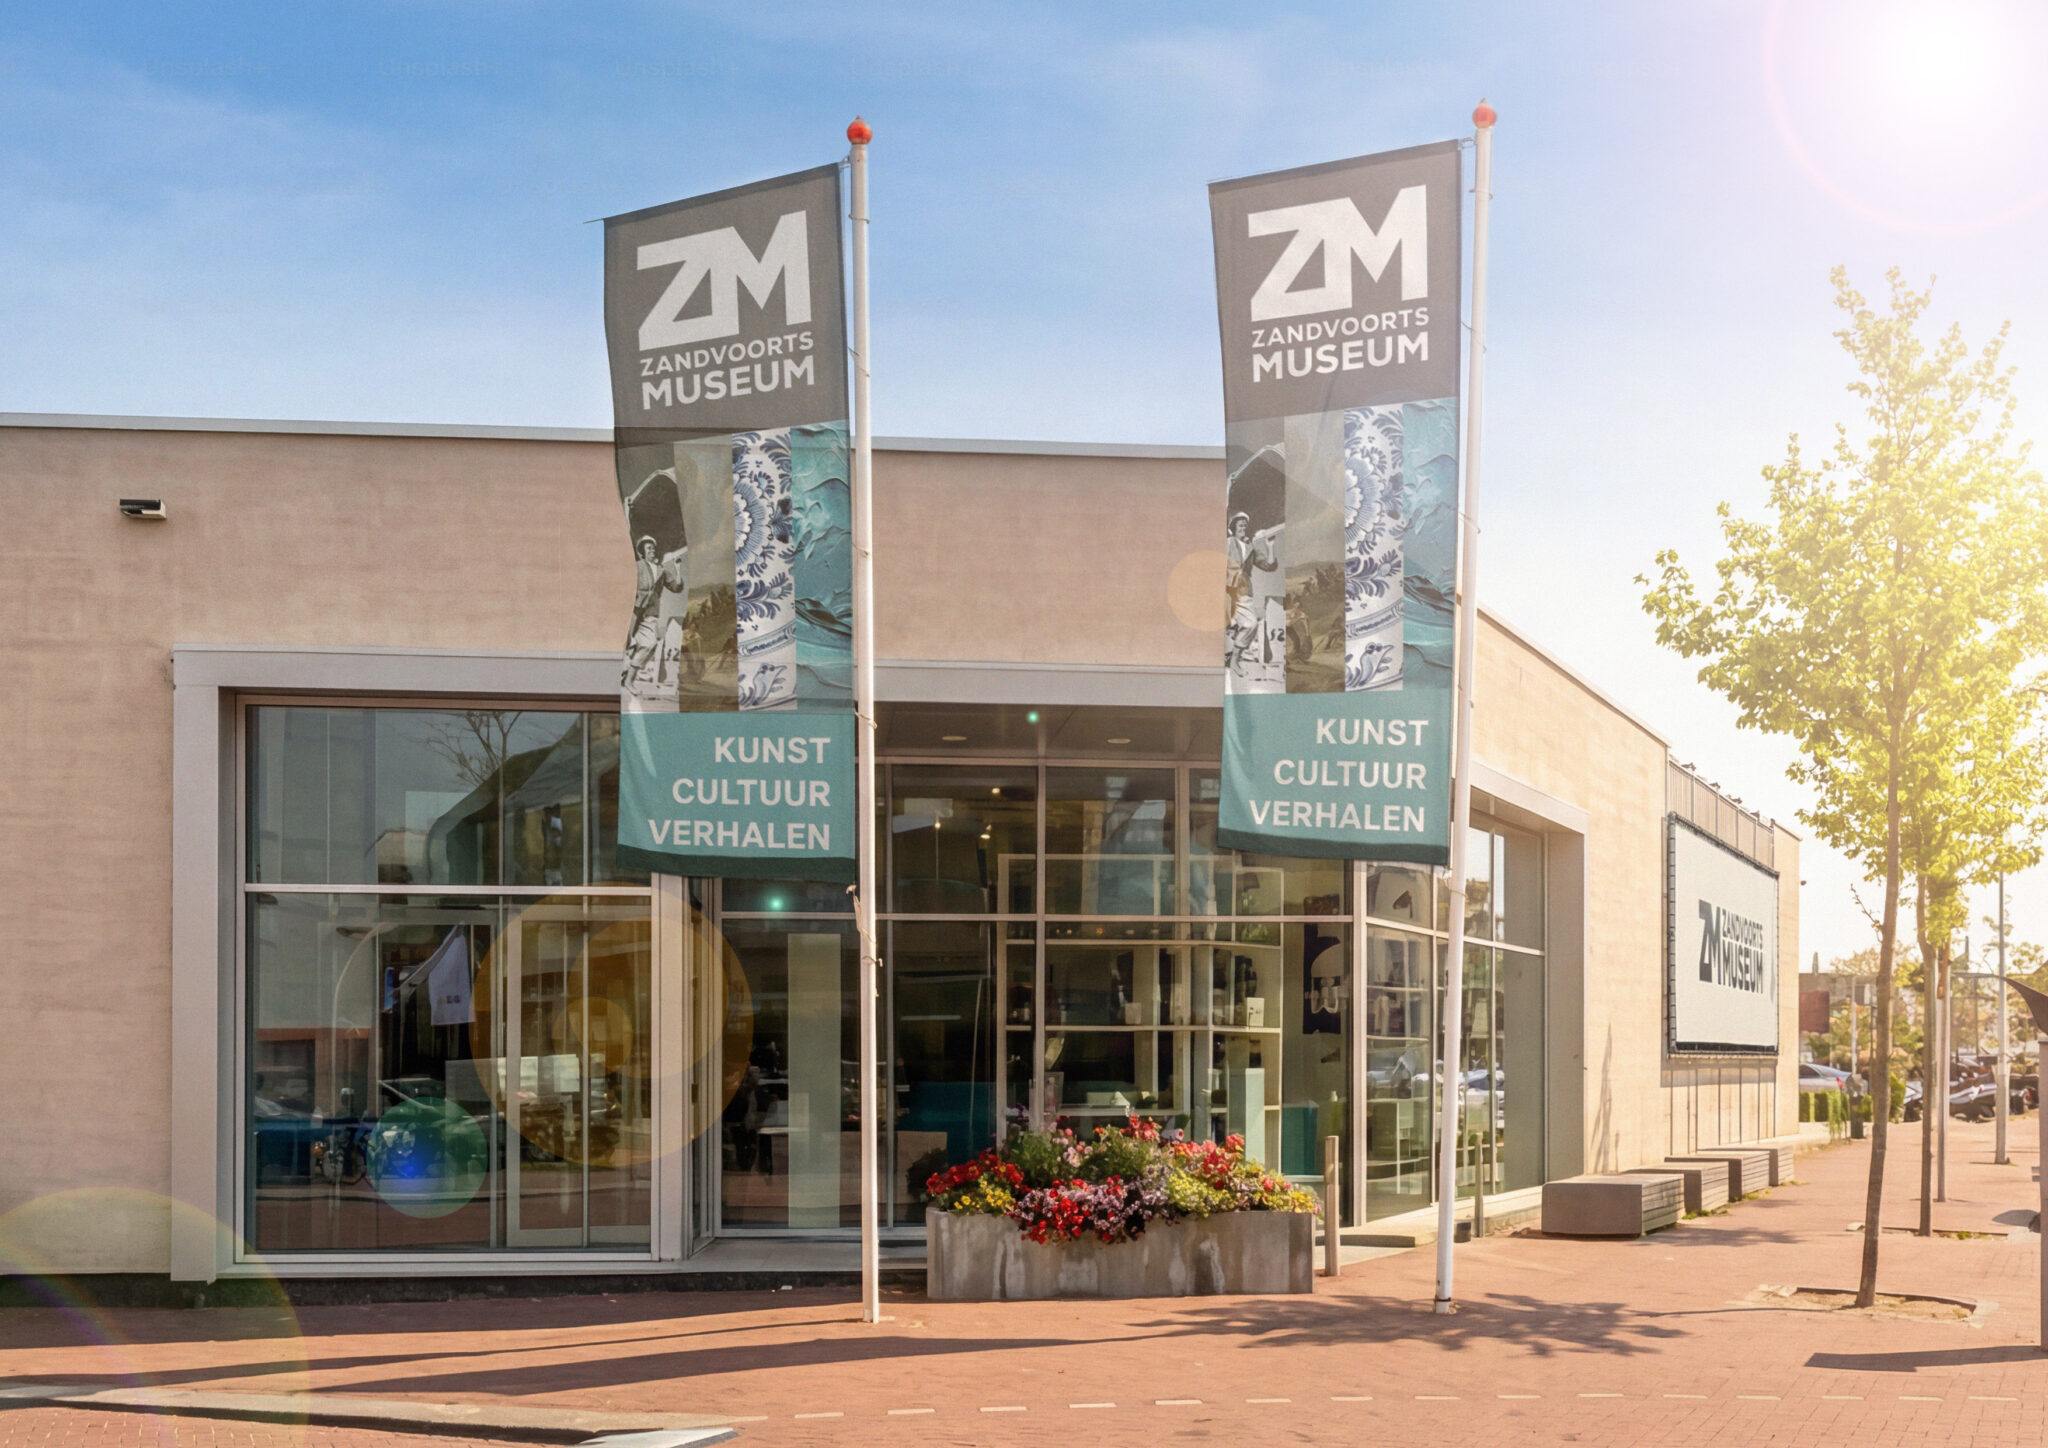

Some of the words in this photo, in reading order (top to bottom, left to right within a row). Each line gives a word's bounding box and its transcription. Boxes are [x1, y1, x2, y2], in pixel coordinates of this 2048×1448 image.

[1247, 184, 1428, 322] ZM
[637, 210, 812, 351] ZM
[1251, 306, 1430, 348] ZANDVOORTS
[639, 331, 814, 377] ZANDVOORTS
[1252, 331, 1429, 383] MUSEUM
[641, 355, 815, 410] MUSEUM
[714, 736, 831, 764] KUNST
[1316, 717, 1429, 746] KUNST
[671, 778, 831, 807] CULTUUR
[1273, 759, 1427, 790] CULTUUR
[648, 819, 830, 851] VERHALEN
[1249, 799, 1426, 833] VERHALEN
[1699, 899, 1721, 985] ZM
[1722, 908, 1763, 950] ZANDVOORTS
[1722, 939, 1763, 994] MUSEUM
